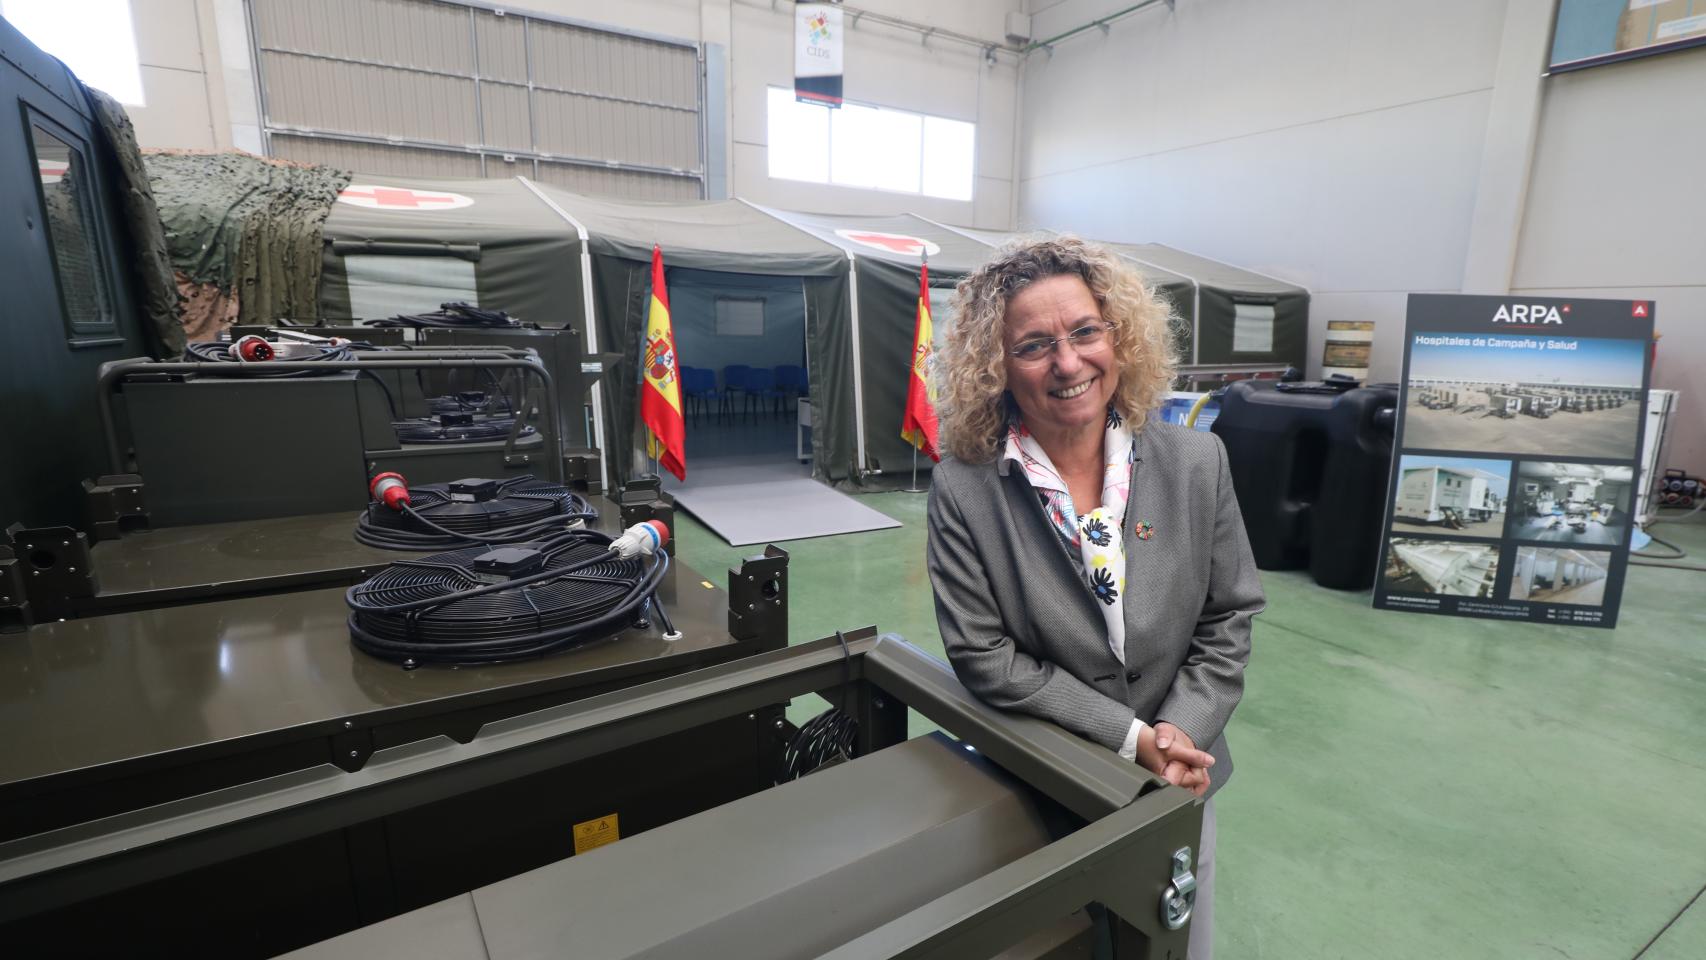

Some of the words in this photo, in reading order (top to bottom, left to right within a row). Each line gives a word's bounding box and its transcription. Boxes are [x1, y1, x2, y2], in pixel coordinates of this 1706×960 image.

[1492, 304, 1563, 324] ARPA
[1415, 335, 1470, 347] Hospitales
[1472, 338, 1485, 347] de
[1487, 338, 1537, 350] Campaña
[1538, 340, 1545, 351] y
[1547, 340, 1577, 351] Salud
